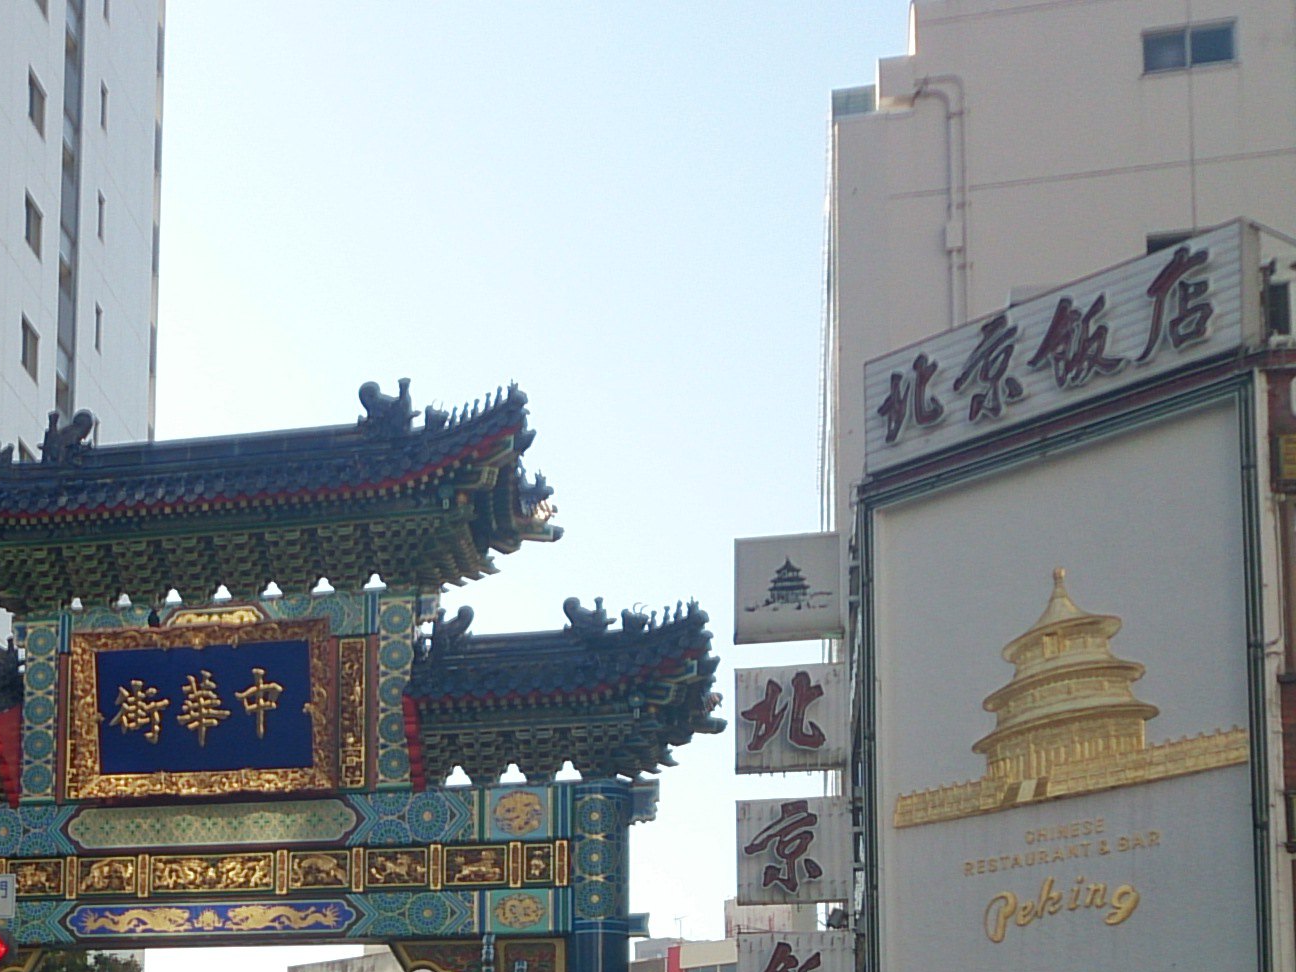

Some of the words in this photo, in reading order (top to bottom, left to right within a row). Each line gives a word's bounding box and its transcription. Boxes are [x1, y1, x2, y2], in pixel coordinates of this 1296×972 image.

[876, 245, 1215, 444] 北京飯店
[963, 842, 1092, 877] RESTAURANT
[1098, 839, 1111, 856] &
[1116, 830, 1162, 852] BAR
[1024, 818, 1106, 845] CHINESE
[983, 875, 1141, 943] Peking
